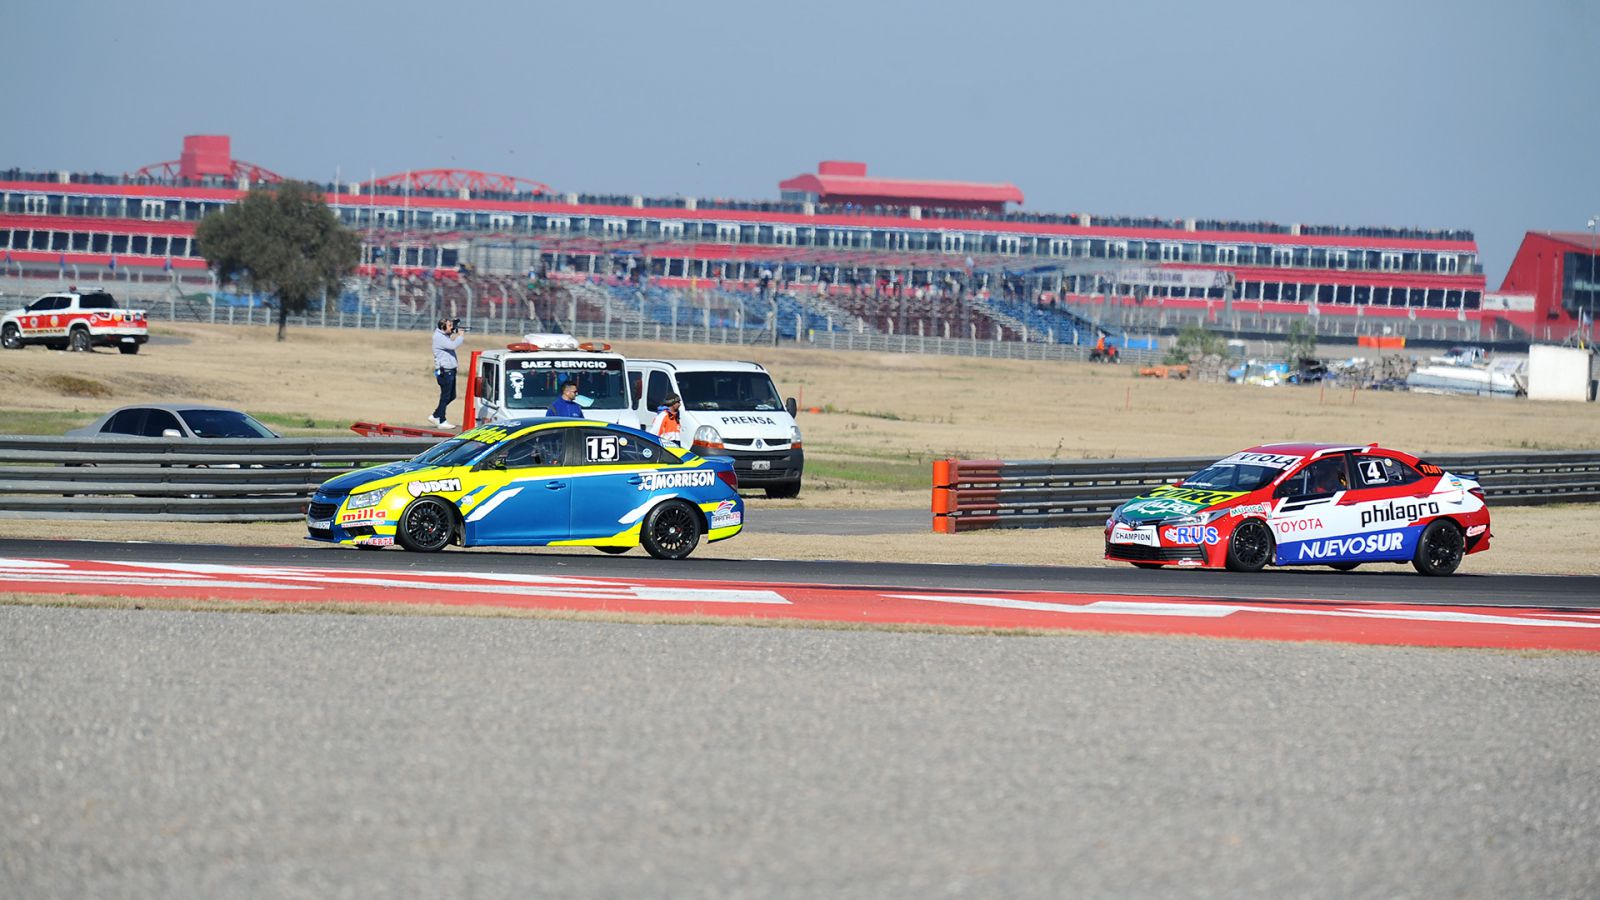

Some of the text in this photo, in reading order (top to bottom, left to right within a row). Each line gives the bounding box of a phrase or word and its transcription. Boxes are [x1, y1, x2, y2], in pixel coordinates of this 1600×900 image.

[521, 361, 607, 369] SAEZ SERVICIO
[721, 416, 776, 426] PRENSA
[588, 438, 616, 459] 15
[1367, 461, 1381, 479] 4
[342, 508, 386, 521] milla
[1361, 501, 1440, 527] philagro
[1273, 518, 1323, 534] TOYOTA
[1116, 532, 1151, 541] CHAMPION
[1177, 526, 1218, 544] RUS
